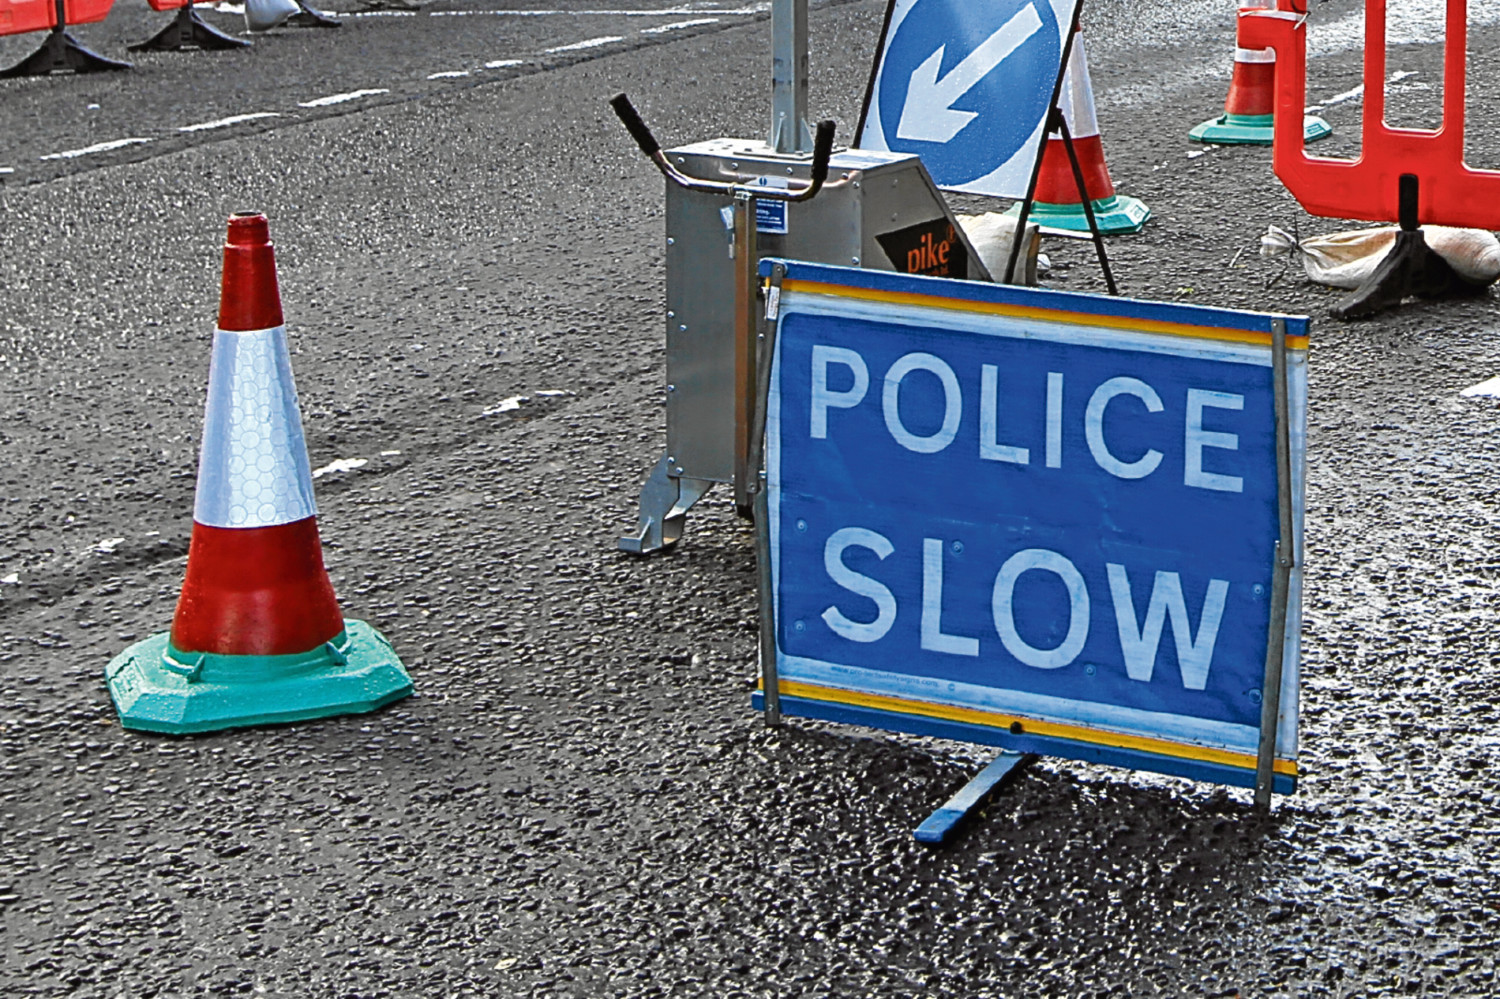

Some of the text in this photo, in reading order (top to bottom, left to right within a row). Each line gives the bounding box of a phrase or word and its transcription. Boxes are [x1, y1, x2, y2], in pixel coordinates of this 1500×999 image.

[907, 232, 951, 273] pike
[809, 344, 1245, 493] POLICE
[820, 526, 1230, 691] SLOW
